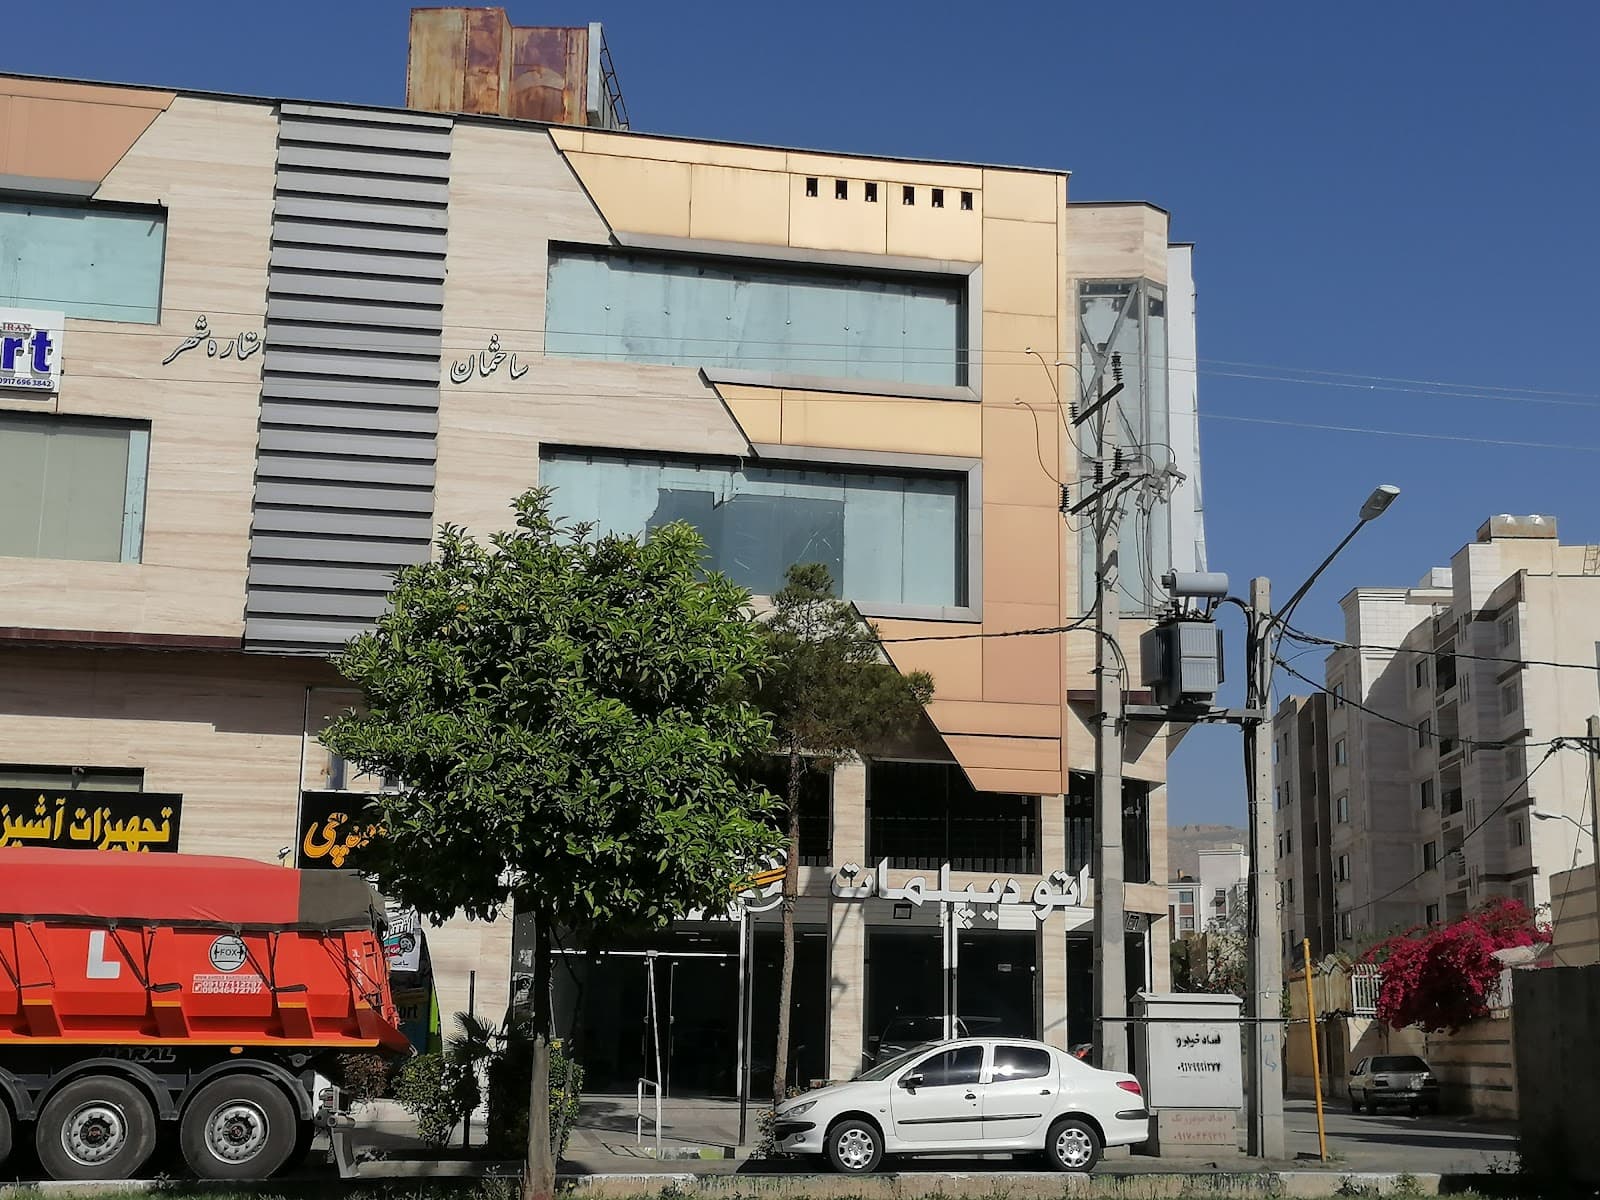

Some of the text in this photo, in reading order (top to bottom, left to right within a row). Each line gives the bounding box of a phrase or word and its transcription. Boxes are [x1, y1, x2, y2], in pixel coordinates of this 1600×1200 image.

[3, 322, 31, 333] IRAN
[162, 314, 211, 365] شهر
[450, 333, 529, 384] ساختمان
[16, 379, 32, 387] 696
[32, 380, 52, 388] 3842
[70, 806, 173, 852] تجهیزات
[86, 930, 121, 979] L
